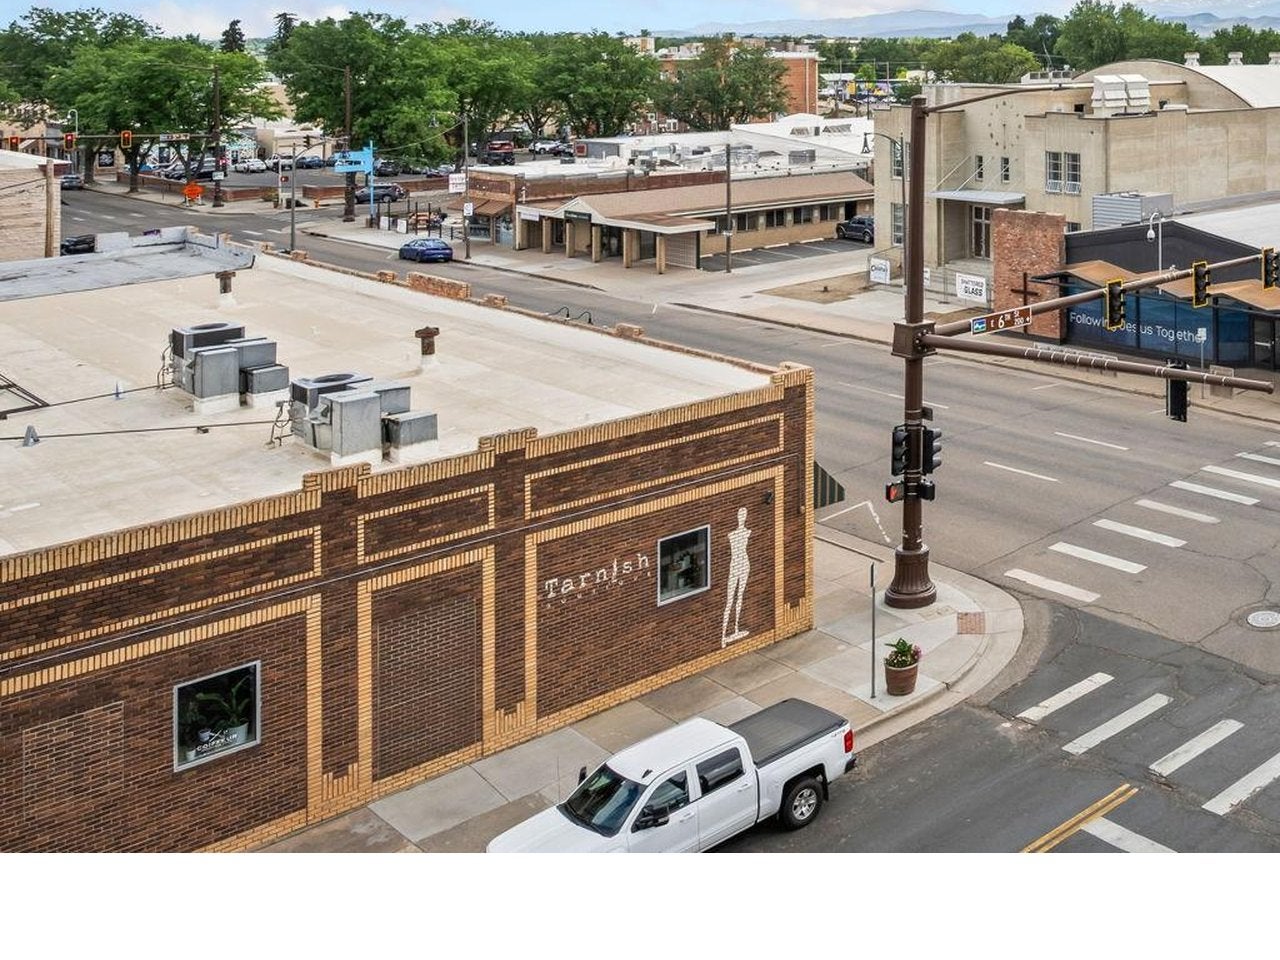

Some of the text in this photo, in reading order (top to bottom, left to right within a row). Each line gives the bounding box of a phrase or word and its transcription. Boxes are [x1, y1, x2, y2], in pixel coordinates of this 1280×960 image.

[963, 286, 983, 297] GLASS
[1156, 324, 1208, 343] Togethe
[545, 553, 650, 599] Tarnish
